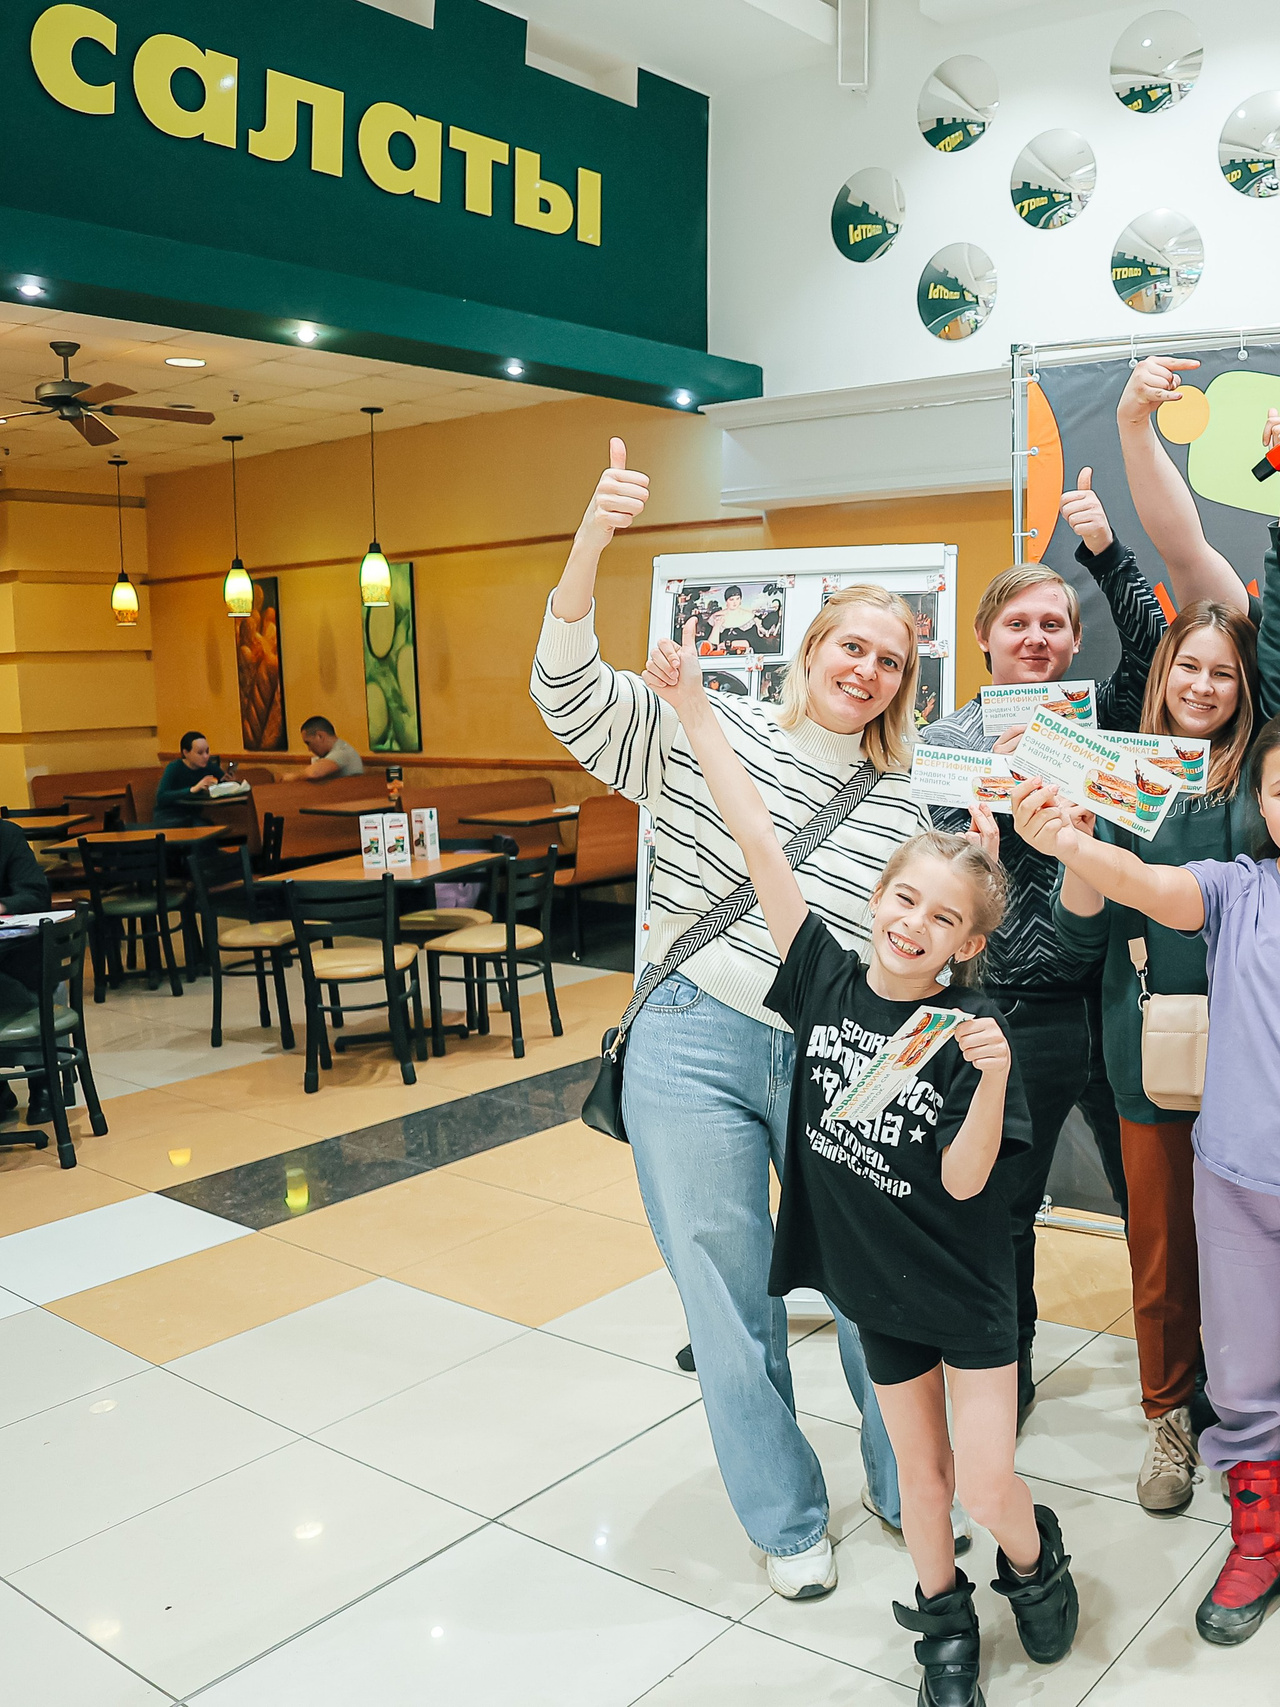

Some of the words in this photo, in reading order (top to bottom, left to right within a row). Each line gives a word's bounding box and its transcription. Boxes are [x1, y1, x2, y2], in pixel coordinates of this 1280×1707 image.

[30, 3, 602, 246] салаты
[983, 686, 1048, 697] ПОДАРОЧНЫЙ
[991, 695, 1041, 704] СЕРТИФИКАТ
[1035, 713, 1120, 762] ПОДАРОЧНЫЙ
[1040, 726, 1106, 766] СЕРТИФИКАТ
[1098, 735, 1159, 747] ДАРОЧНЫЙ
[917, 749, 992, 766] ПОДАРОЧНЫЙ
[924, 759, 982, 773] СЕРТИФИКАТ
[1062, 753, 1071, 763] 15
[1166, 796, 1225, 817] UTURE
[1117, 816, 1150, 833] SUBWAY
[830, 1053, 889, 1117] ПОДАРОЧНЫЙ
[844, 1062, 890, 1112] СЕРТИФИКАТ
